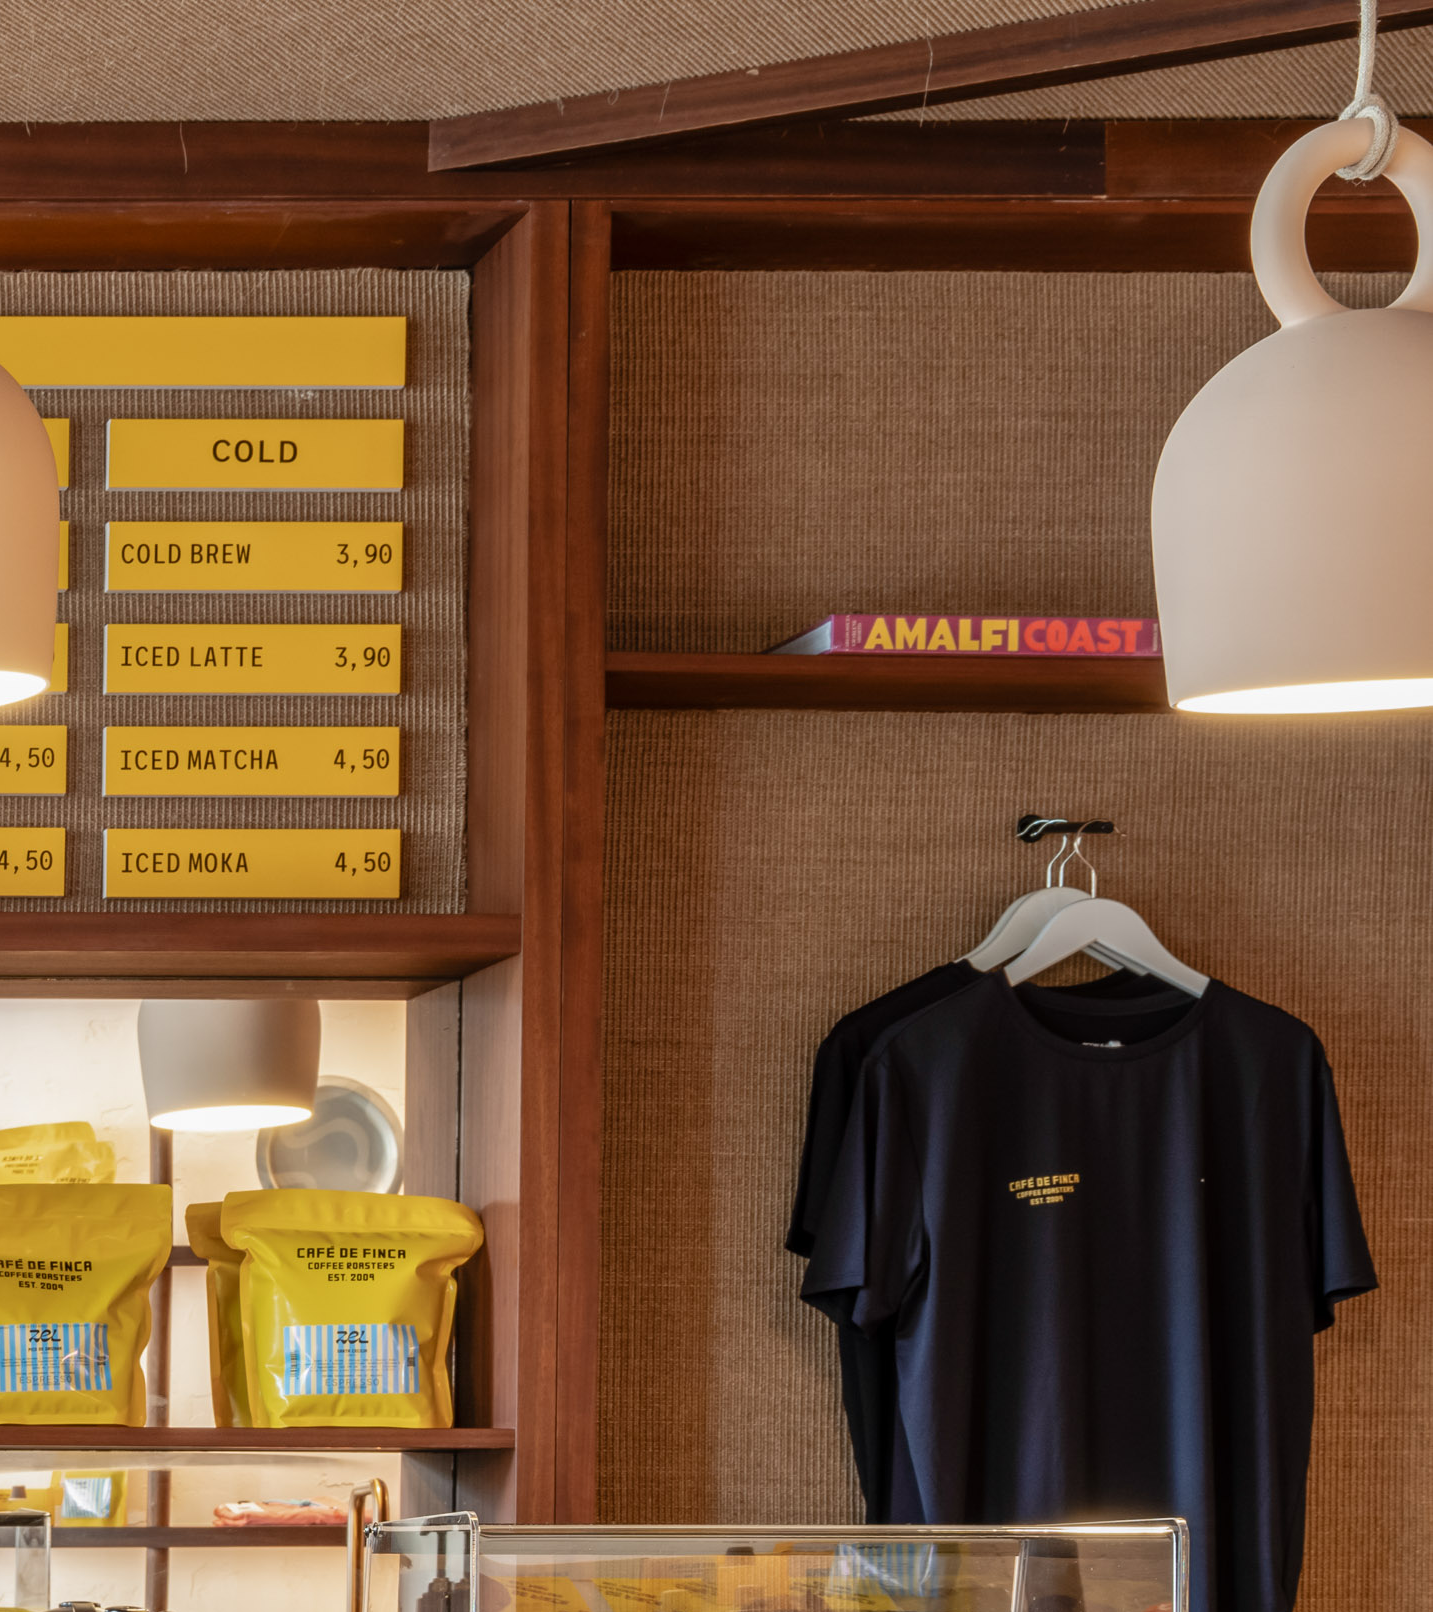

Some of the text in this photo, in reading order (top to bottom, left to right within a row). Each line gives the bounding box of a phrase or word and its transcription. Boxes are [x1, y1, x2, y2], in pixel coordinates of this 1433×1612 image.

[212, 439, 298, 464] COLD
[121, 543, 393, 569] COLD BREW 3,90
[864, 617, 1019, 653] AMALFI
[1024, 619, 1143, 654] COAST
[120, 645, 391, 672] ICED LATTE 3,90
[0, 747, 55, 772] 4,50
[120, 749, 390, 774] ICED MATCHA 4,50
[121, 852, 391, 877] ICED MOKA 4,50
[1009, 1173, 1080, 1192] CAFÉ DE FINCA
[297, 1246, 406, 1259] CAFÉ DE FINCA
[28, 1261, 46, 1270] DE
[50, 1261, 92, 1272] FINCA
[350, 1273, 375, 1281] 2009
[40, 1282, 64, 1291] 2009
